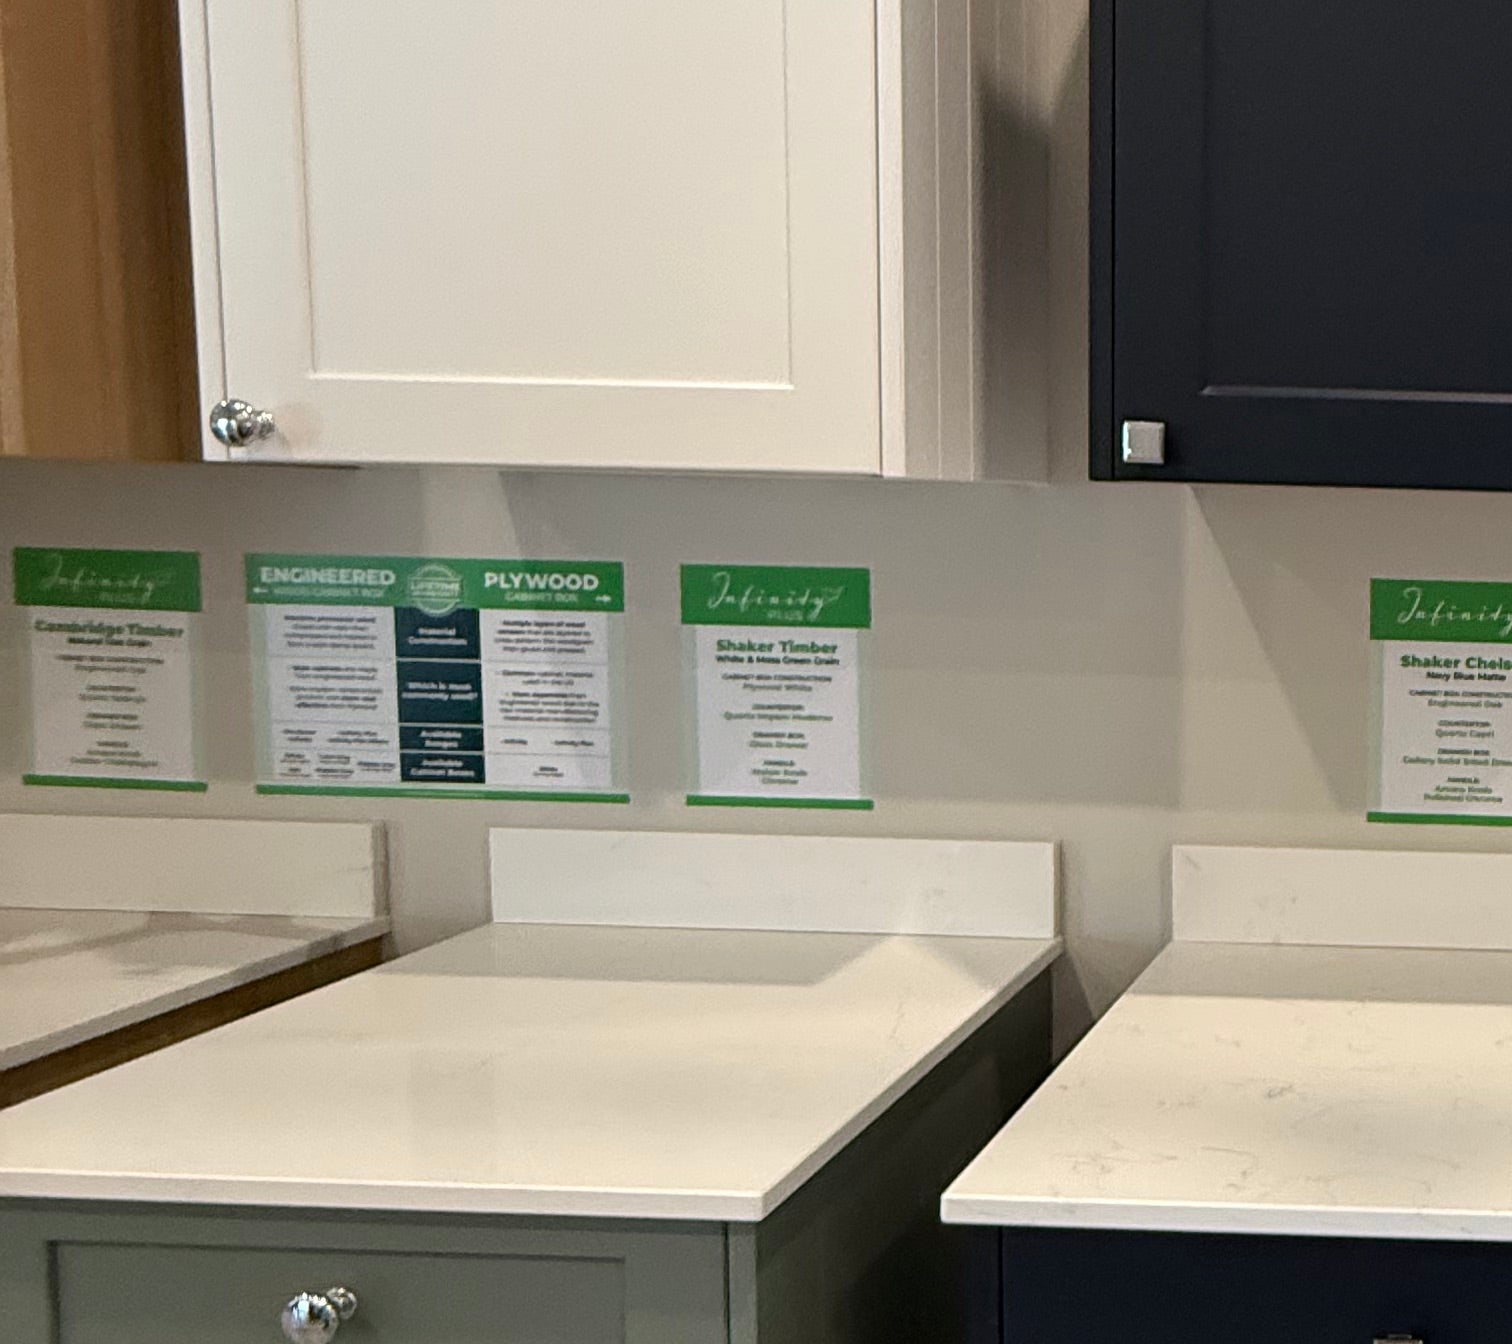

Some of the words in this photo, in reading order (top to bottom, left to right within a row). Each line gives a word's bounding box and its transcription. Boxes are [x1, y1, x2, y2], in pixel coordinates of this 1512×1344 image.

[260, 566, 396, 586] ENGINEERED
[484, 571, 599, 591] PLYWOOD
[708, 571, 826, 622] Infinity
[716, 638, 775, 653] Shaker
[778, 640, 838, 654] Timber
[1401, 654, 1460, 668] Shaker
[1426, 671, 1450, 681] Navy
[1454, 671, 1475, 680] Blue
